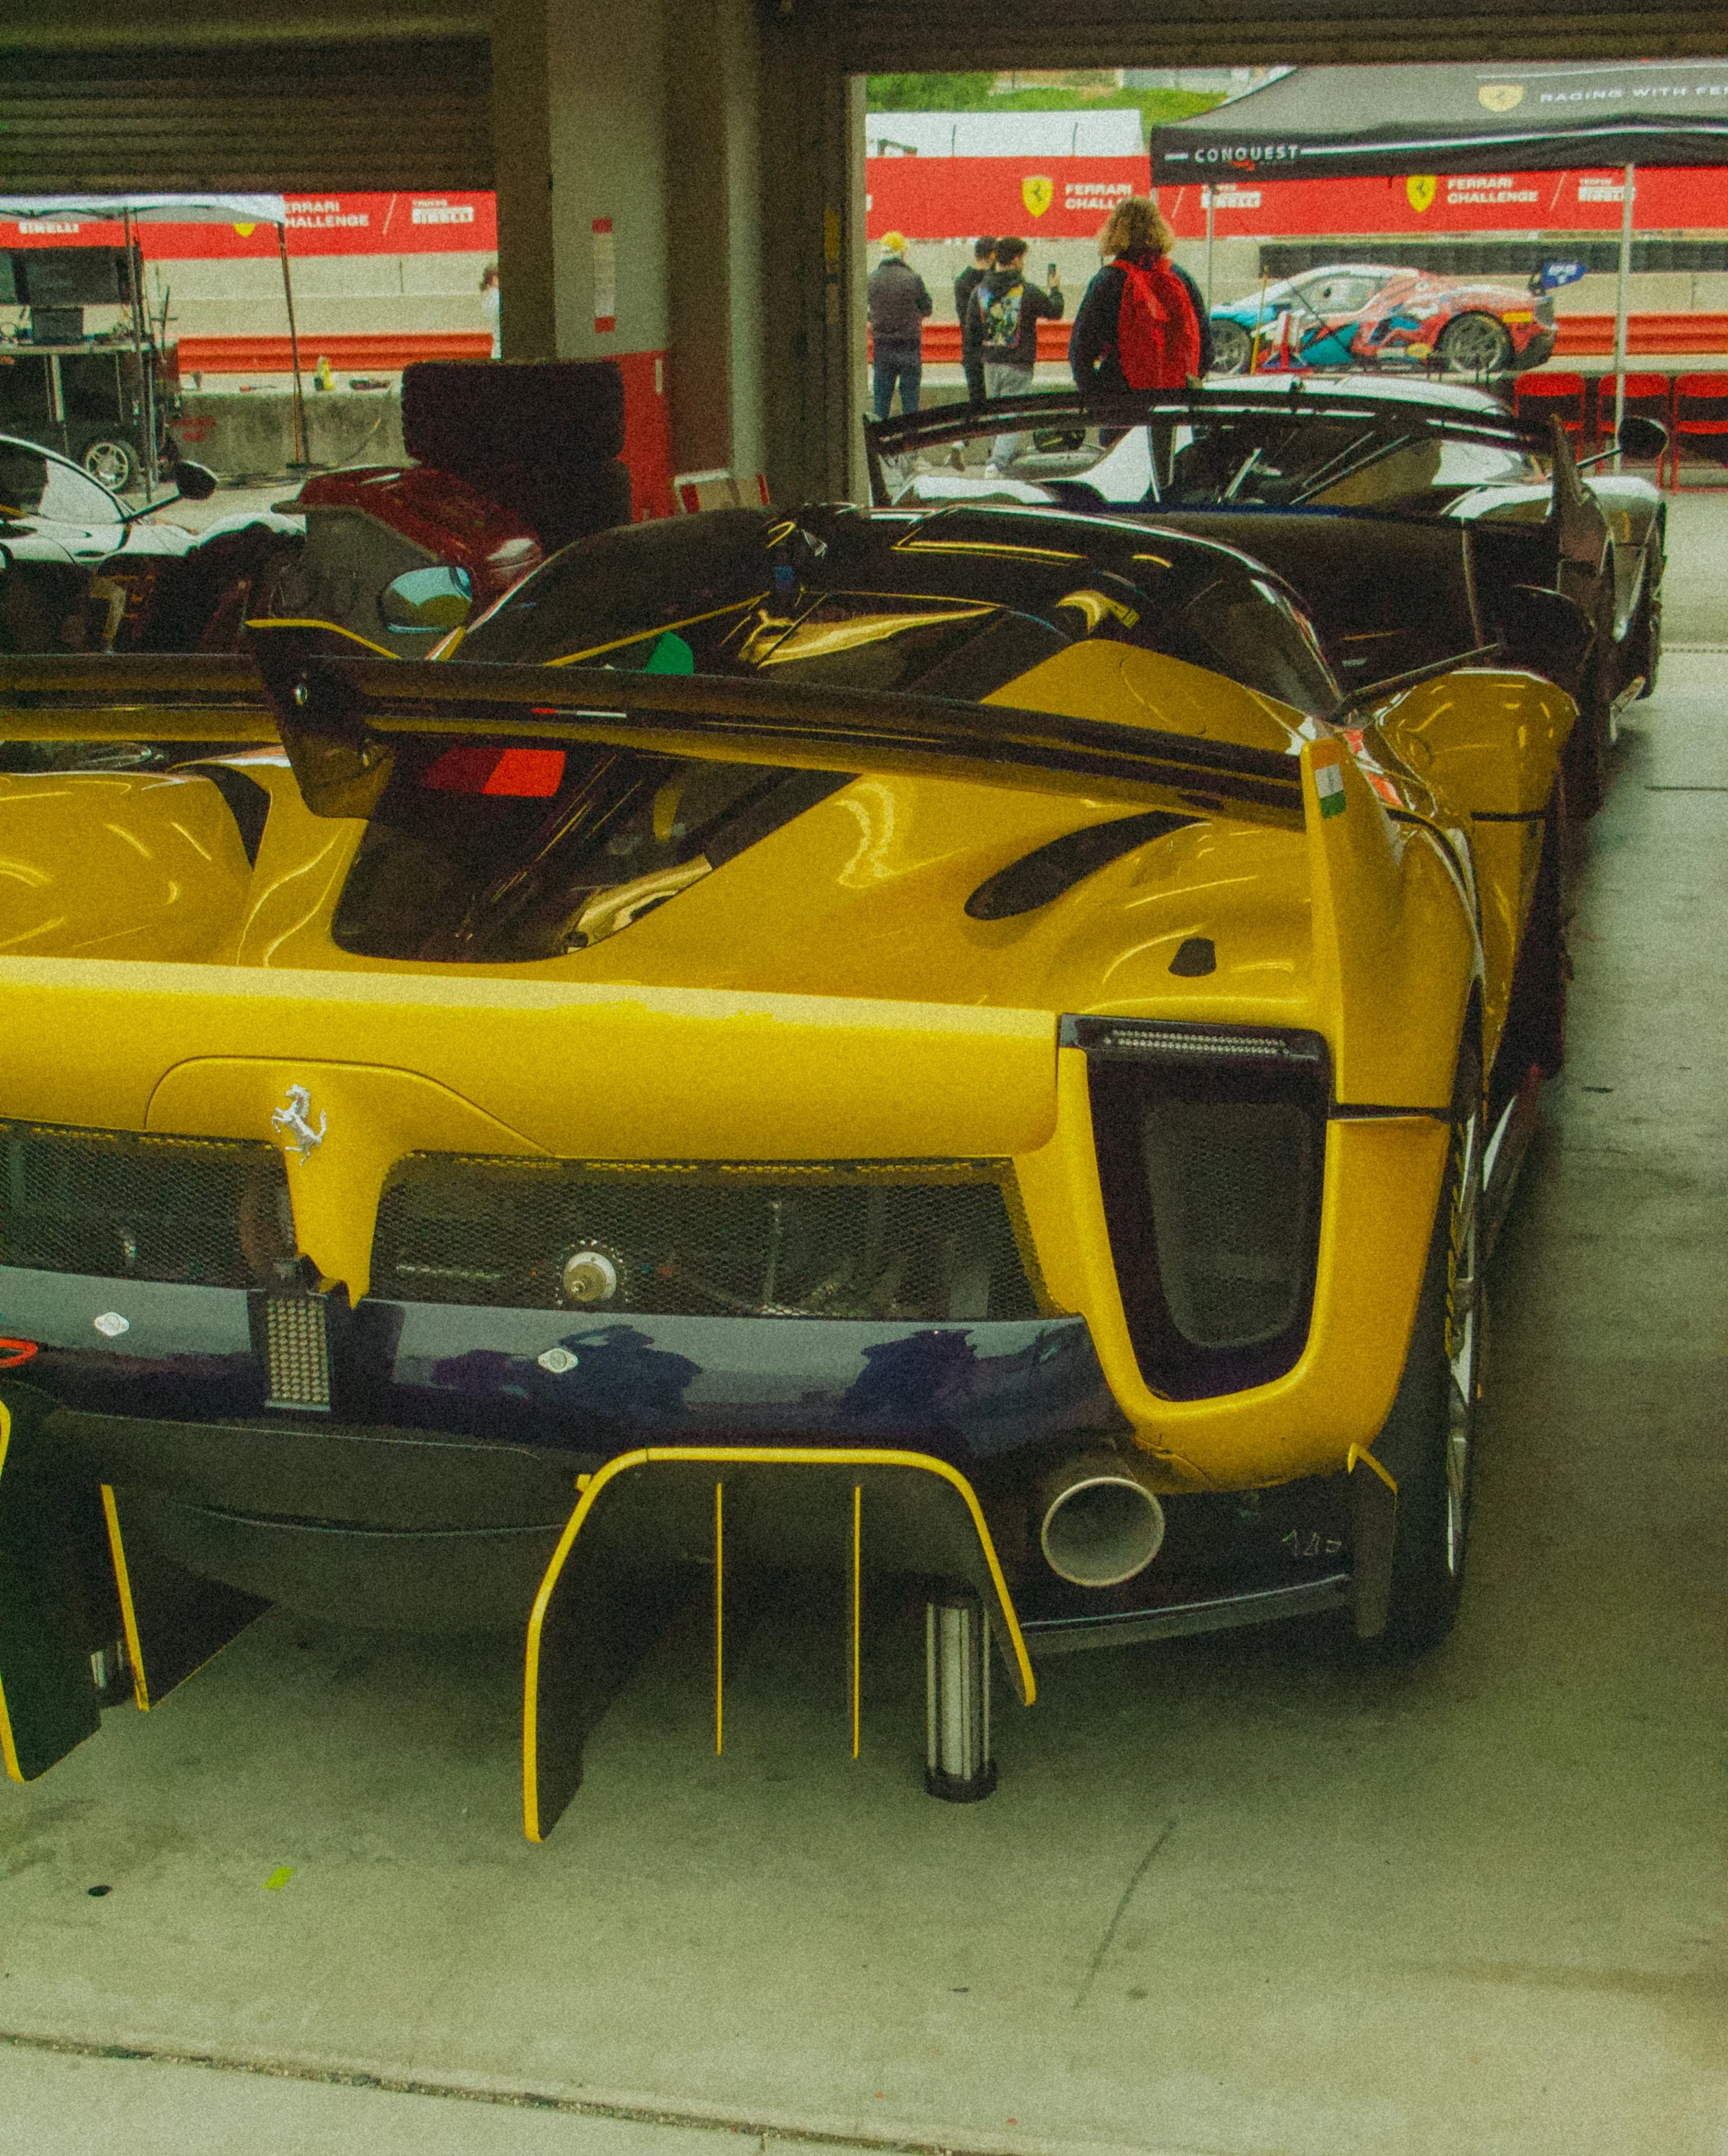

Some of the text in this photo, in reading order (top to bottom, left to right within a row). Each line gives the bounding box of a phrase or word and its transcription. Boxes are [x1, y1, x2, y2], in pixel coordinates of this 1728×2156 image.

[1539, 89, 1624, 103] RACING
[1633, 86, 1688, 97] WITH
[1194, 144, 1298, 163] CONQUEST
[1065, 182, 1131, 196] FERRARI
[1447, 177, 1513, 190] FERRARI
[1201, 191, 1261, 209] PRELLI
[1447, 191, 1539, 204] CHALLENGE
[284, 200, 340, 214] ERRARI
[283, 214, 369, 228] HALLENGE
[412, 207, 474, 224] PIRELLI
